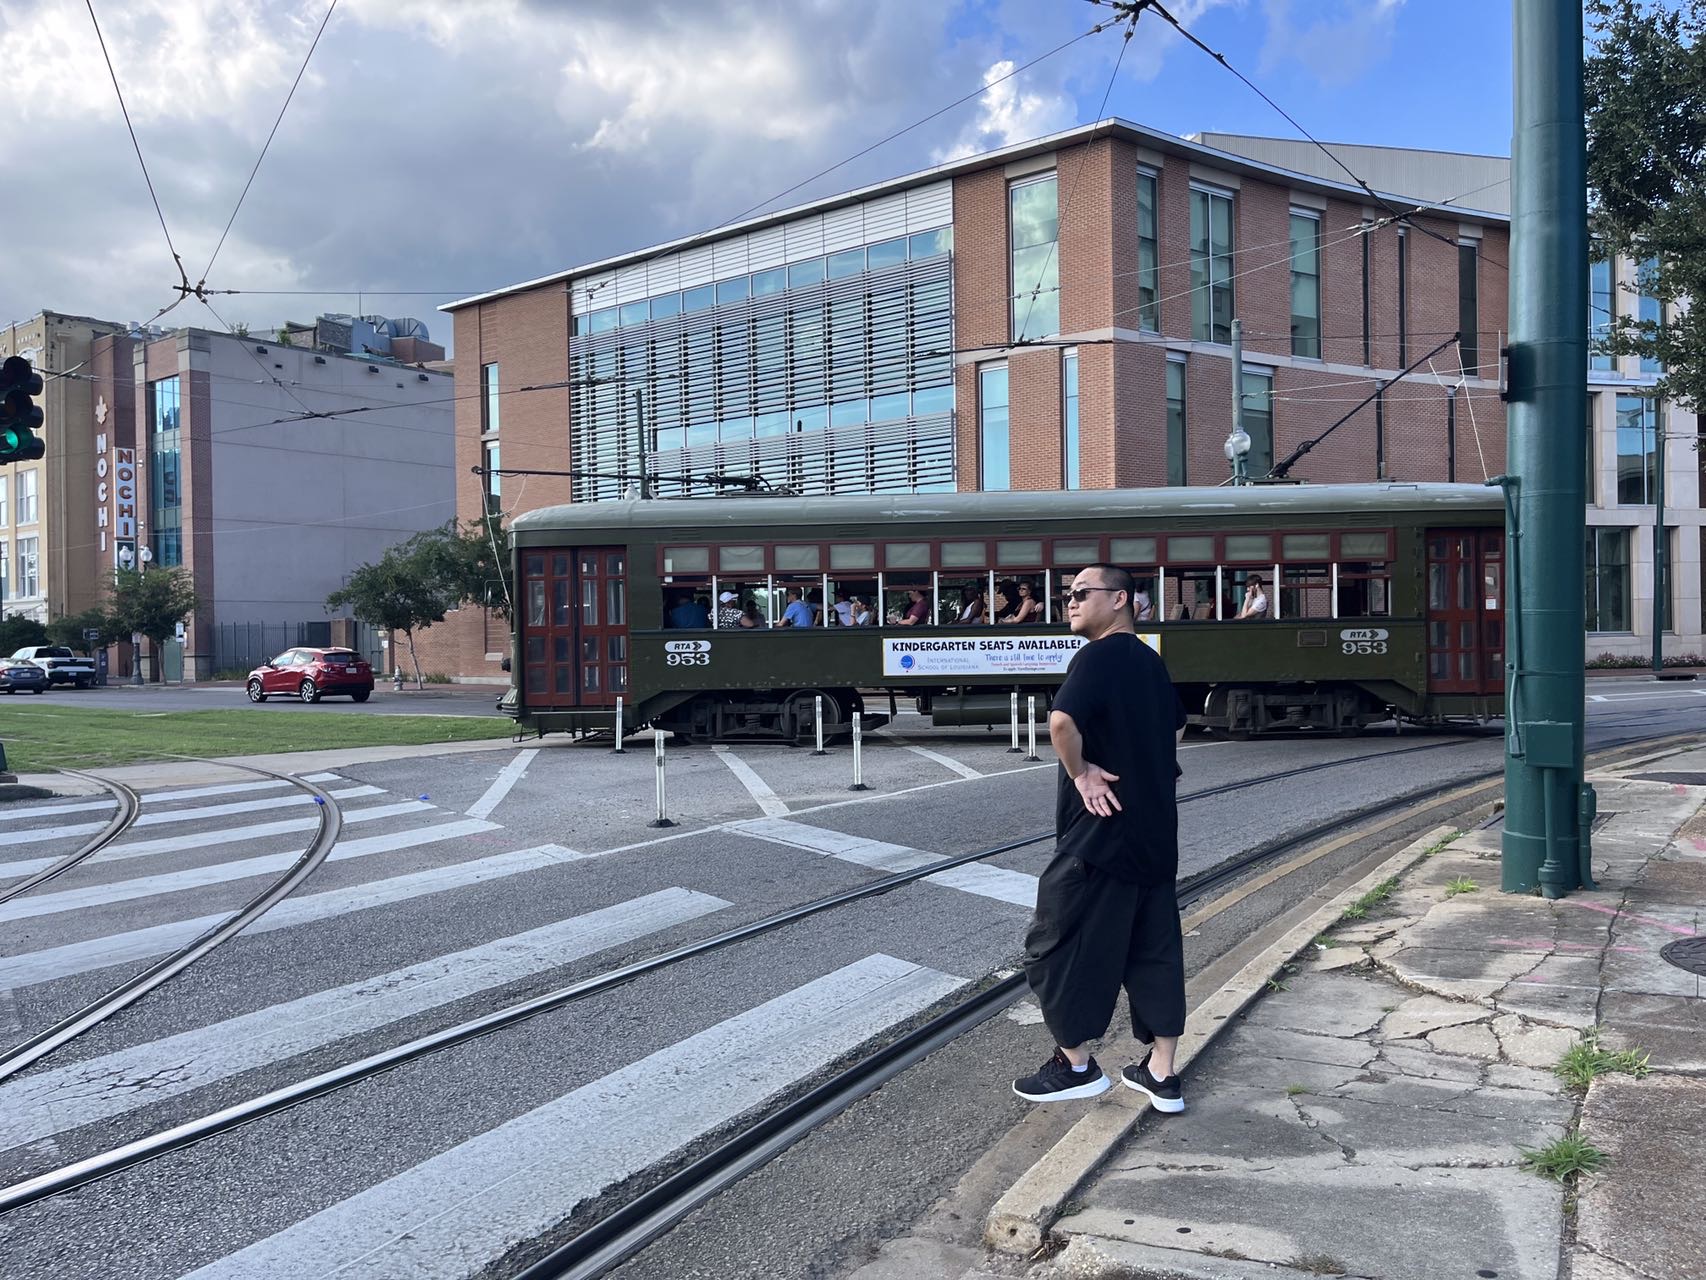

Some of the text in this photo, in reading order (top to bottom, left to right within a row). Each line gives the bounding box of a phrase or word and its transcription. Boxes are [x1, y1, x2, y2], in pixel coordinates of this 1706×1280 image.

[97, 433, 108, 552] NOCHI
[118, 449, 133, 536] NOCHI
[1350, 631, 1367, 639] RTA
[892, 639, 1081, 652] KINDERGARTEN SEATS AVAILABLE!
[1342, 641, 1388, 655] 953
[666, 652, 710, 666] 953
